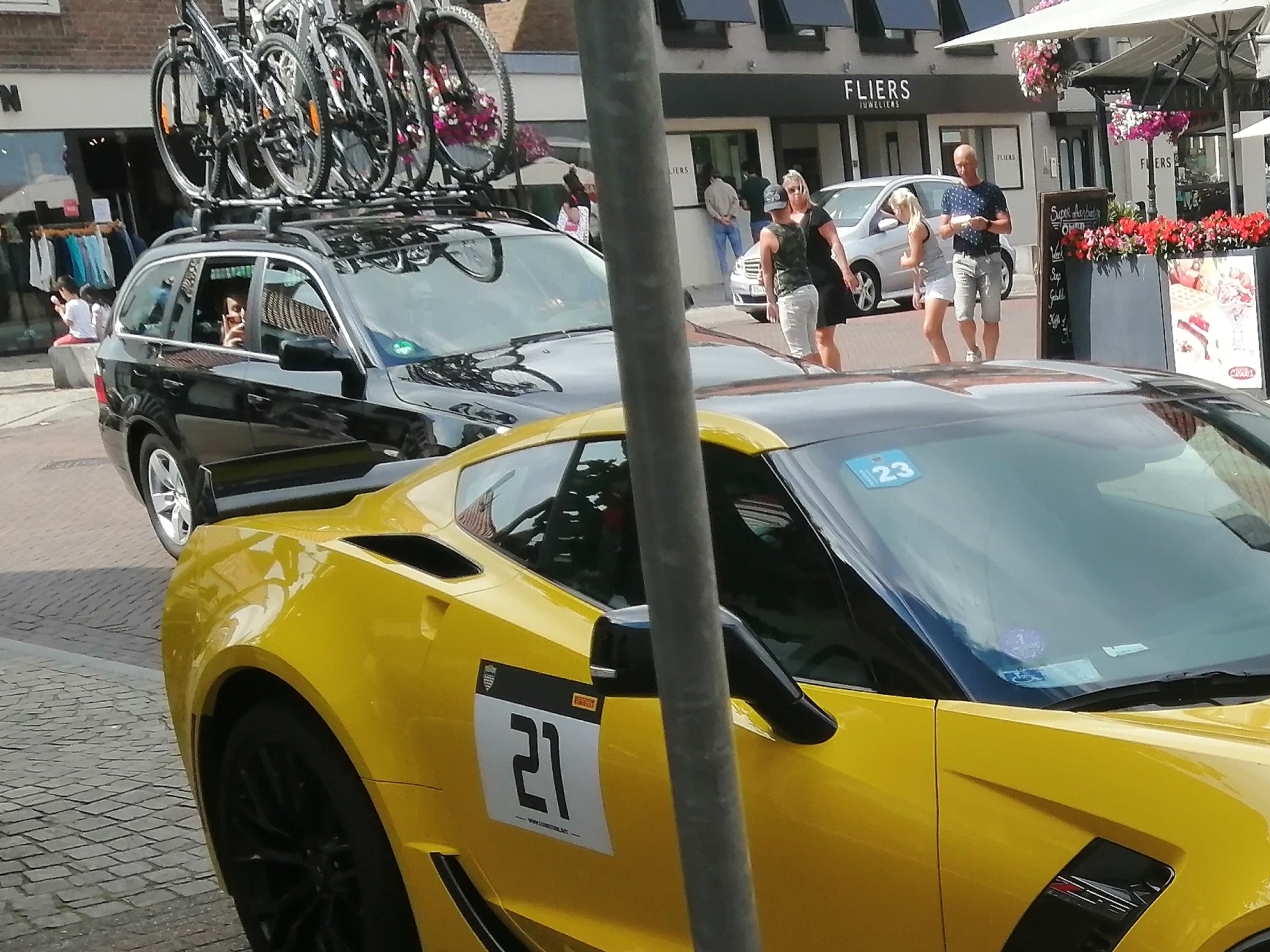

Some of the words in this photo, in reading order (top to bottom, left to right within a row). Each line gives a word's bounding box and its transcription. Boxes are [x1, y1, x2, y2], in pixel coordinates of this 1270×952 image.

[844, 79, 910, 100] FLIERS
[1140, 157, 1172, 169] FLERS
[872, 462, 914, 482] 23
[511, 712, 570, 821] 21
